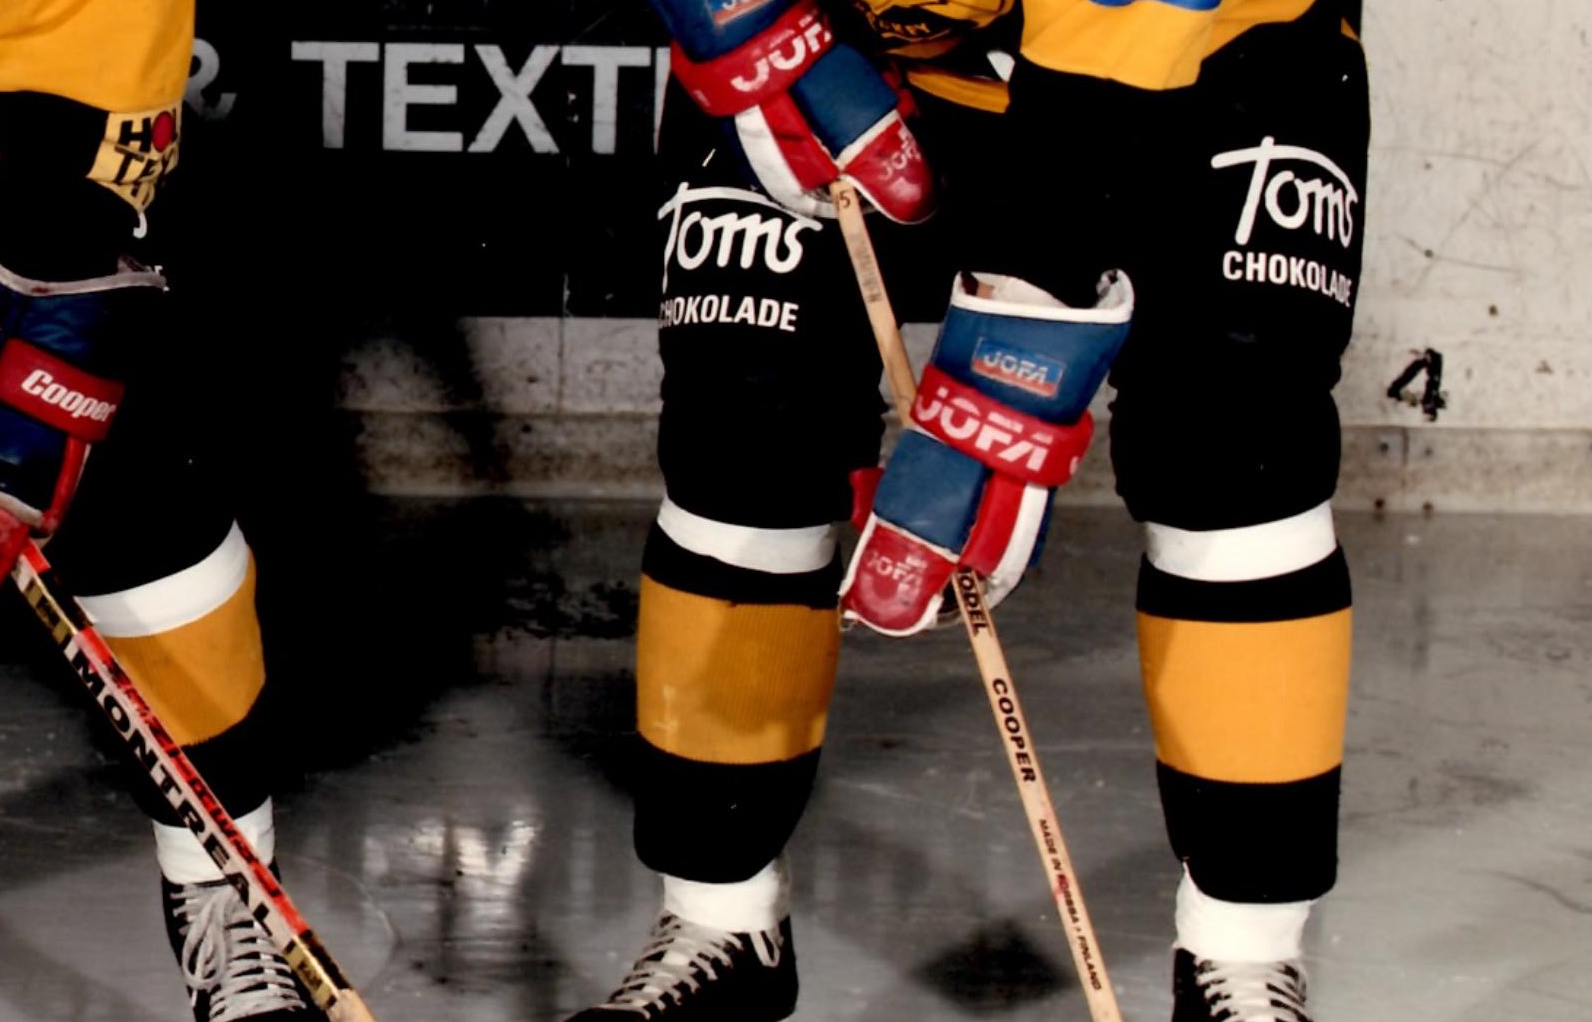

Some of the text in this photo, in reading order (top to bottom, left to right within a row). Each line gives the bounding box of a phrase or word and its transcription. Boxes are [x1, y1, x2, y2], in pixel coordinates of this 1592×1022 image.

[657, 181, 824, 295] Toms
[1211, 135, 1358, 249] Toms
[1223, 250, 1352, 308] CHOKOLADE
[20, 369, 117, 424] Cooper
[983, 351, 1049, 386] JOFA
[915, 386, 1055, 473] JOFA
[992, 677, 1037, 784] COOPER
[70, 648, 275, 938] MONTREAL
[1038, 818, 1059, 858] MADE
[1077, 934, 1103, 991] FINLAND
